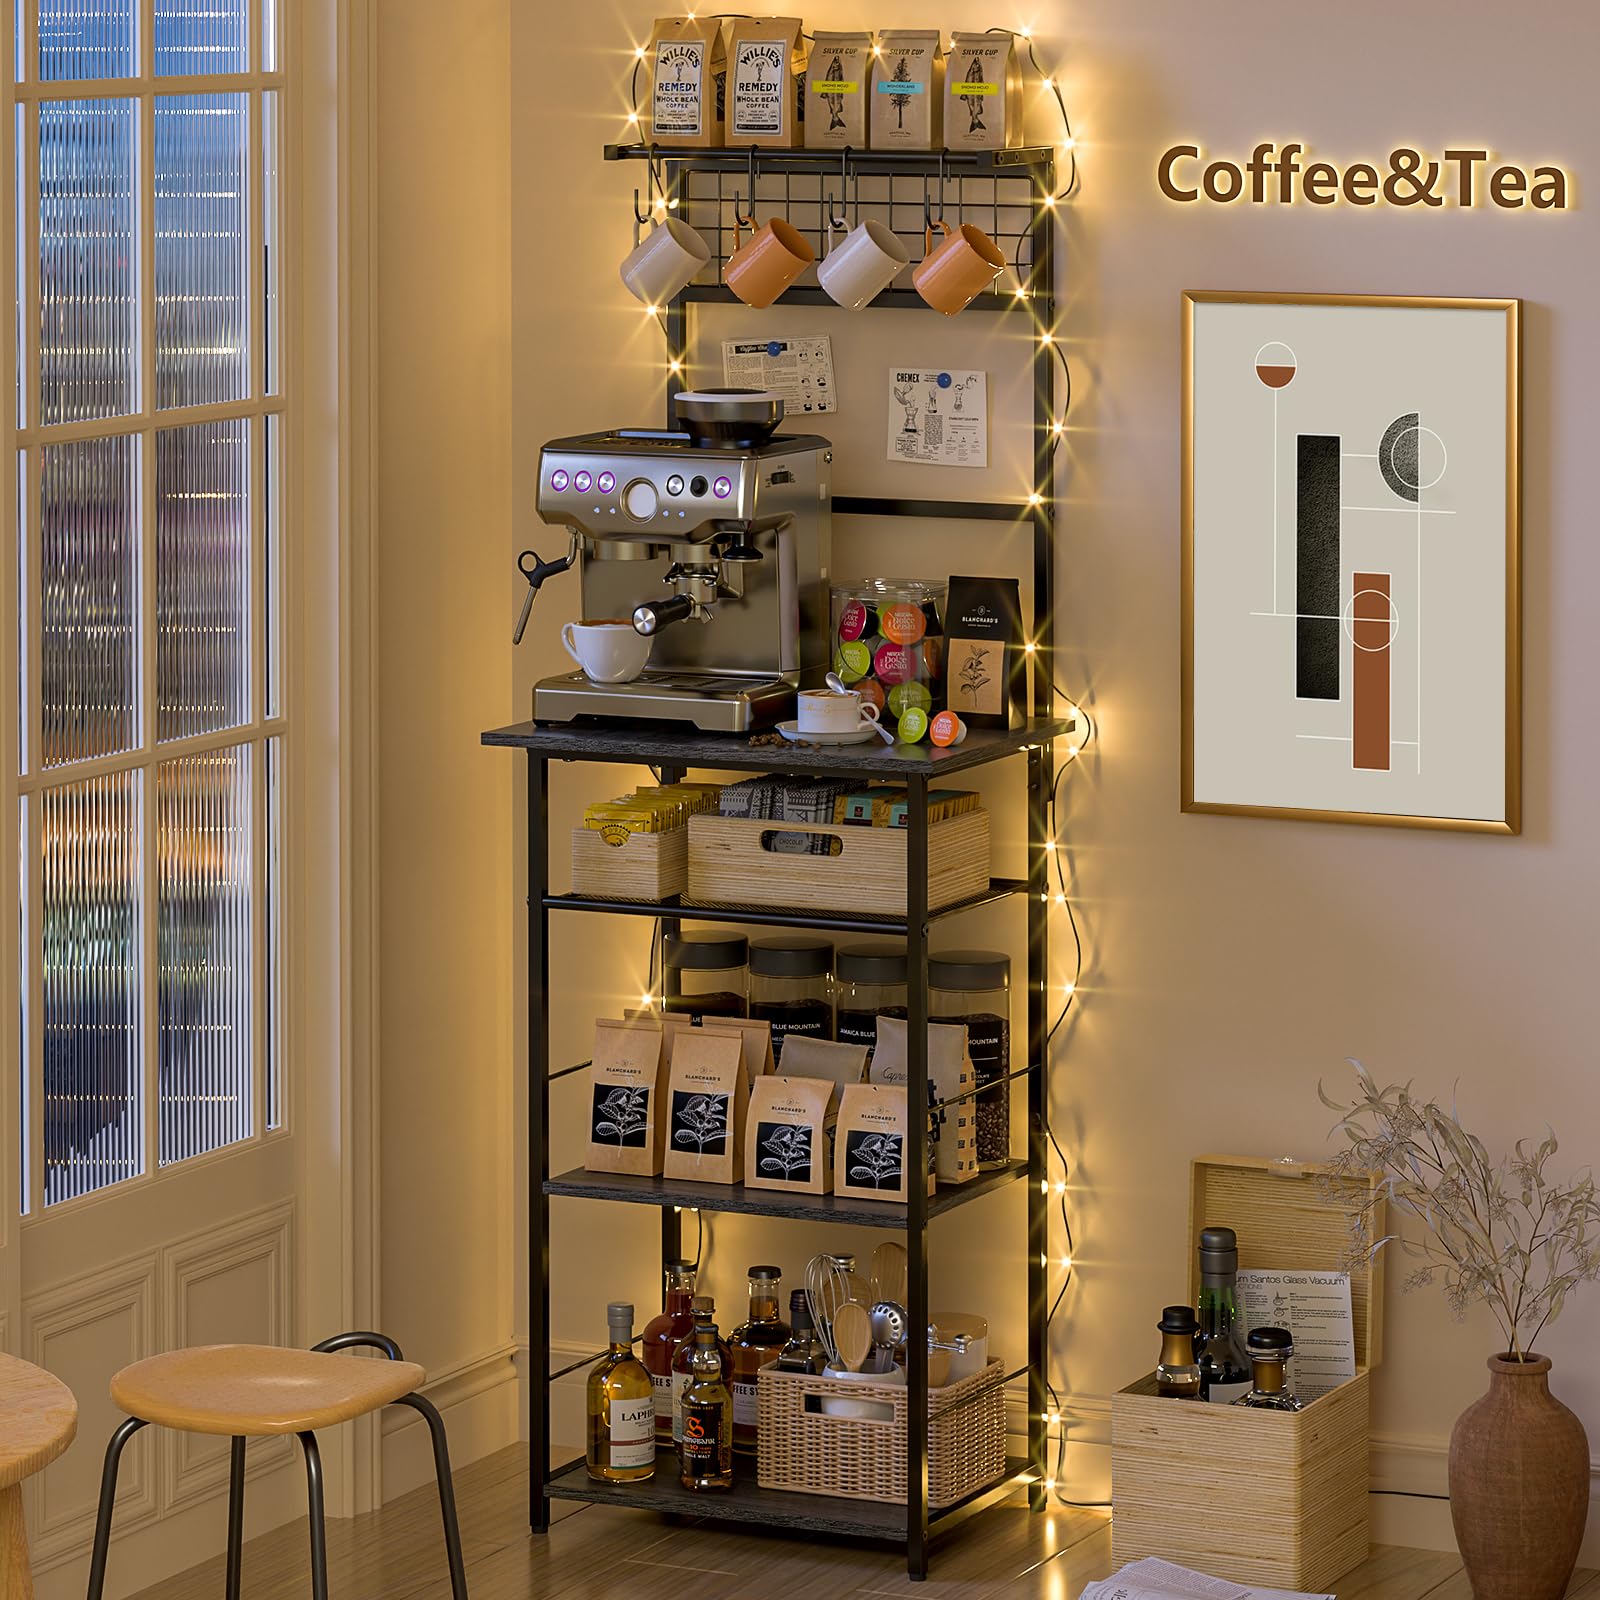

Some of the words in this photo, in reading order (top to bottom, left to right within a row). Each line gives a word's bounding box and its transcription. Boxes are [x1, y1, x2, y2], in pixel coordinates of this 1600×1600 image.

[822, 47, 844, 55] SILVER
[845, 47, 858, 55] CUP
[888, 48, 910, 56] SILVER
[911, 48, 925, 56] CUP
[961, 48, 984, 56] SILVER
[984, 48, 999, 56] CUP
[659, 46, 701, 69] WILLIE'S
[739, 46, 781, 69] WILLIE'S
[658, 82, 698, 92] REMEDY
[738, 82, 778, 92] REMEDY
[656, 95, 679, 103] WHOLE
[680, 95, 699, 103] BEAN
[736, 95, 760, 103] WHOLE
[761, 95, 780, 103] BEAN
[1156, 143, 1567, 209] Coffee&Tea
[896, 372, 920, 383] CHEMEX
[961, 616, 999, 624] BLANCHARD'S
[788, 1022, 821, 1031] MOUNTAIN
[860, 1030, 876, 1038] BLUE
[605, 1067, 642, 1075] BLANCHARD'S
[685, 1074, 721, 1082] BLANCHARD'S
[771, 1105, 807, 1113] BLANCHARD'S
[861, 1113, 897, 1122] BLANCHARD'S
[1250, 1274, 1281, 1284] Santos
[1282, 1275, 1307, 1285] Glass
[1308, 1276, 1345, 1286] Vacuum
